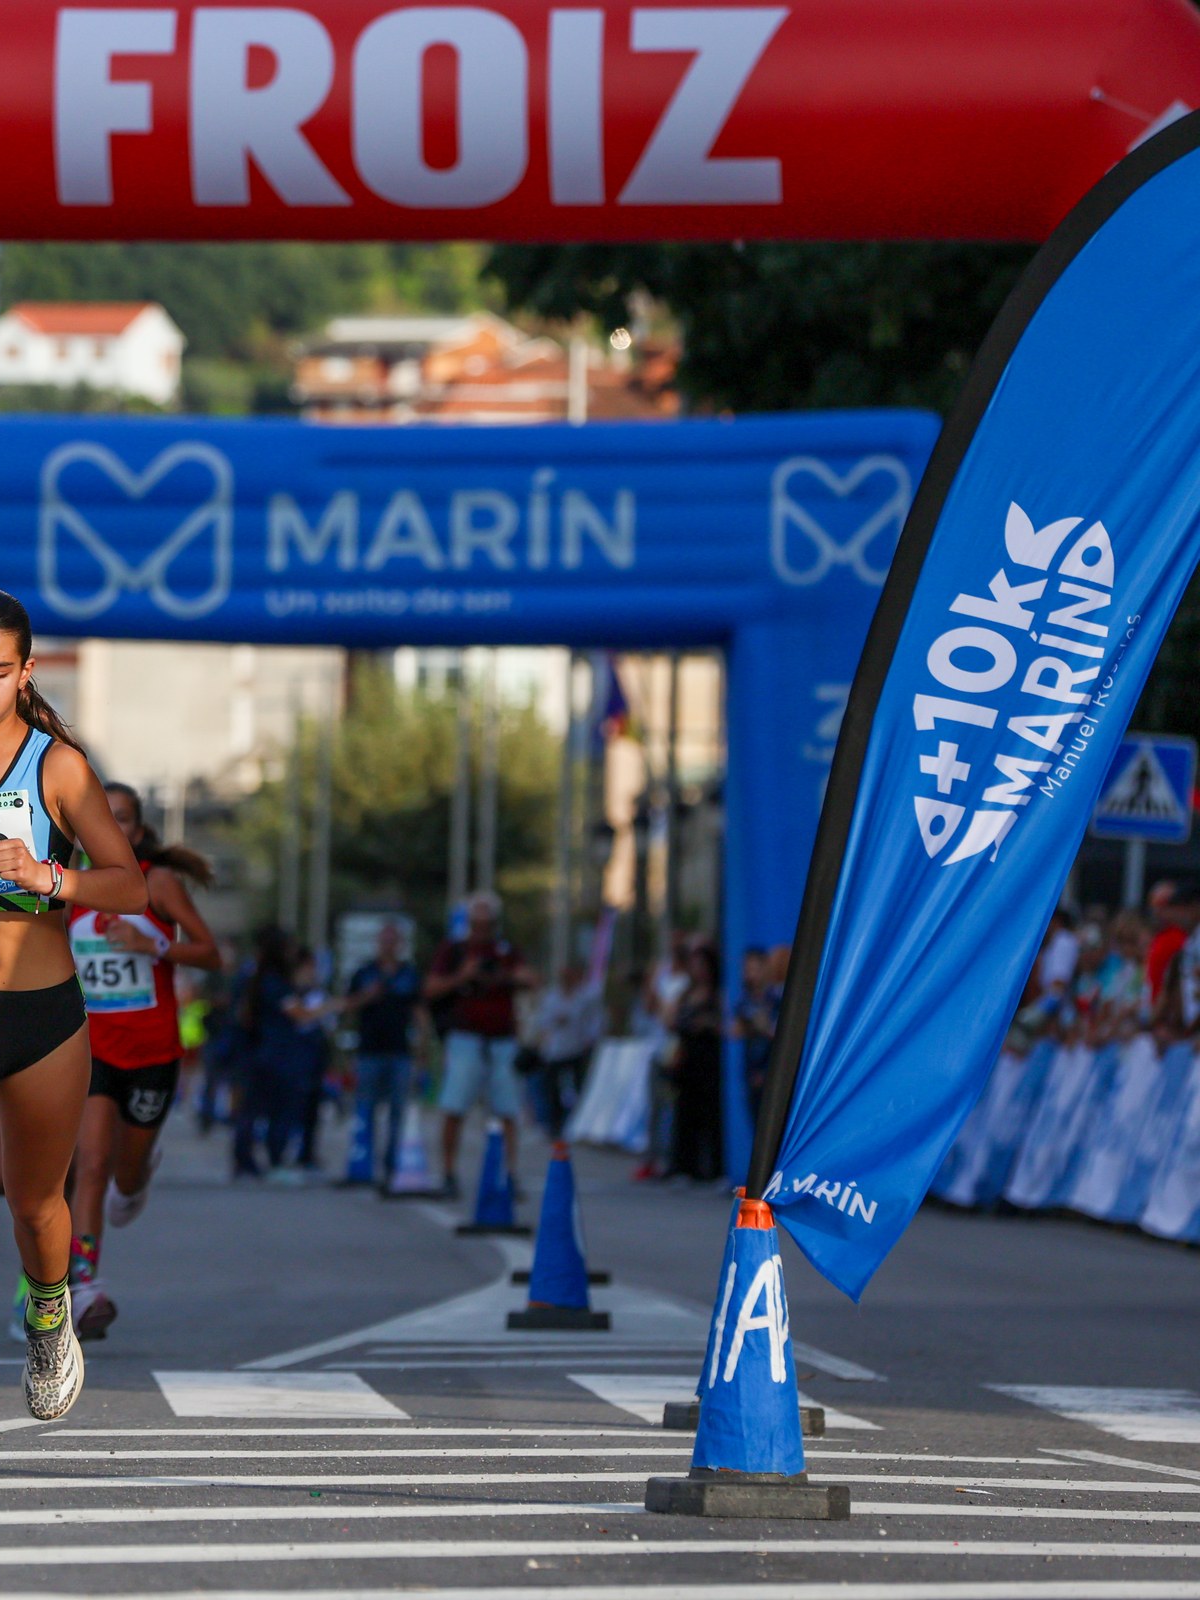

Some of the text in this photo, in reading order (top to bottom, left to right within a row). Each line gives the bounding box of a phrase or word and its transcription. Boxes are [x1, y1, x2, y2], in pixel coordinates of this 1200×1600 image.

[53, 6, 791, 208] FROIZ
[267, 467, 637, 572] MARÍN
[982, 581, 1111, 806] MARÍN
[1039, 715, 1099, 798] Manuel
[83, 957, 139, 988] 451
[793, 1172, 878, 1224] MRÍN
